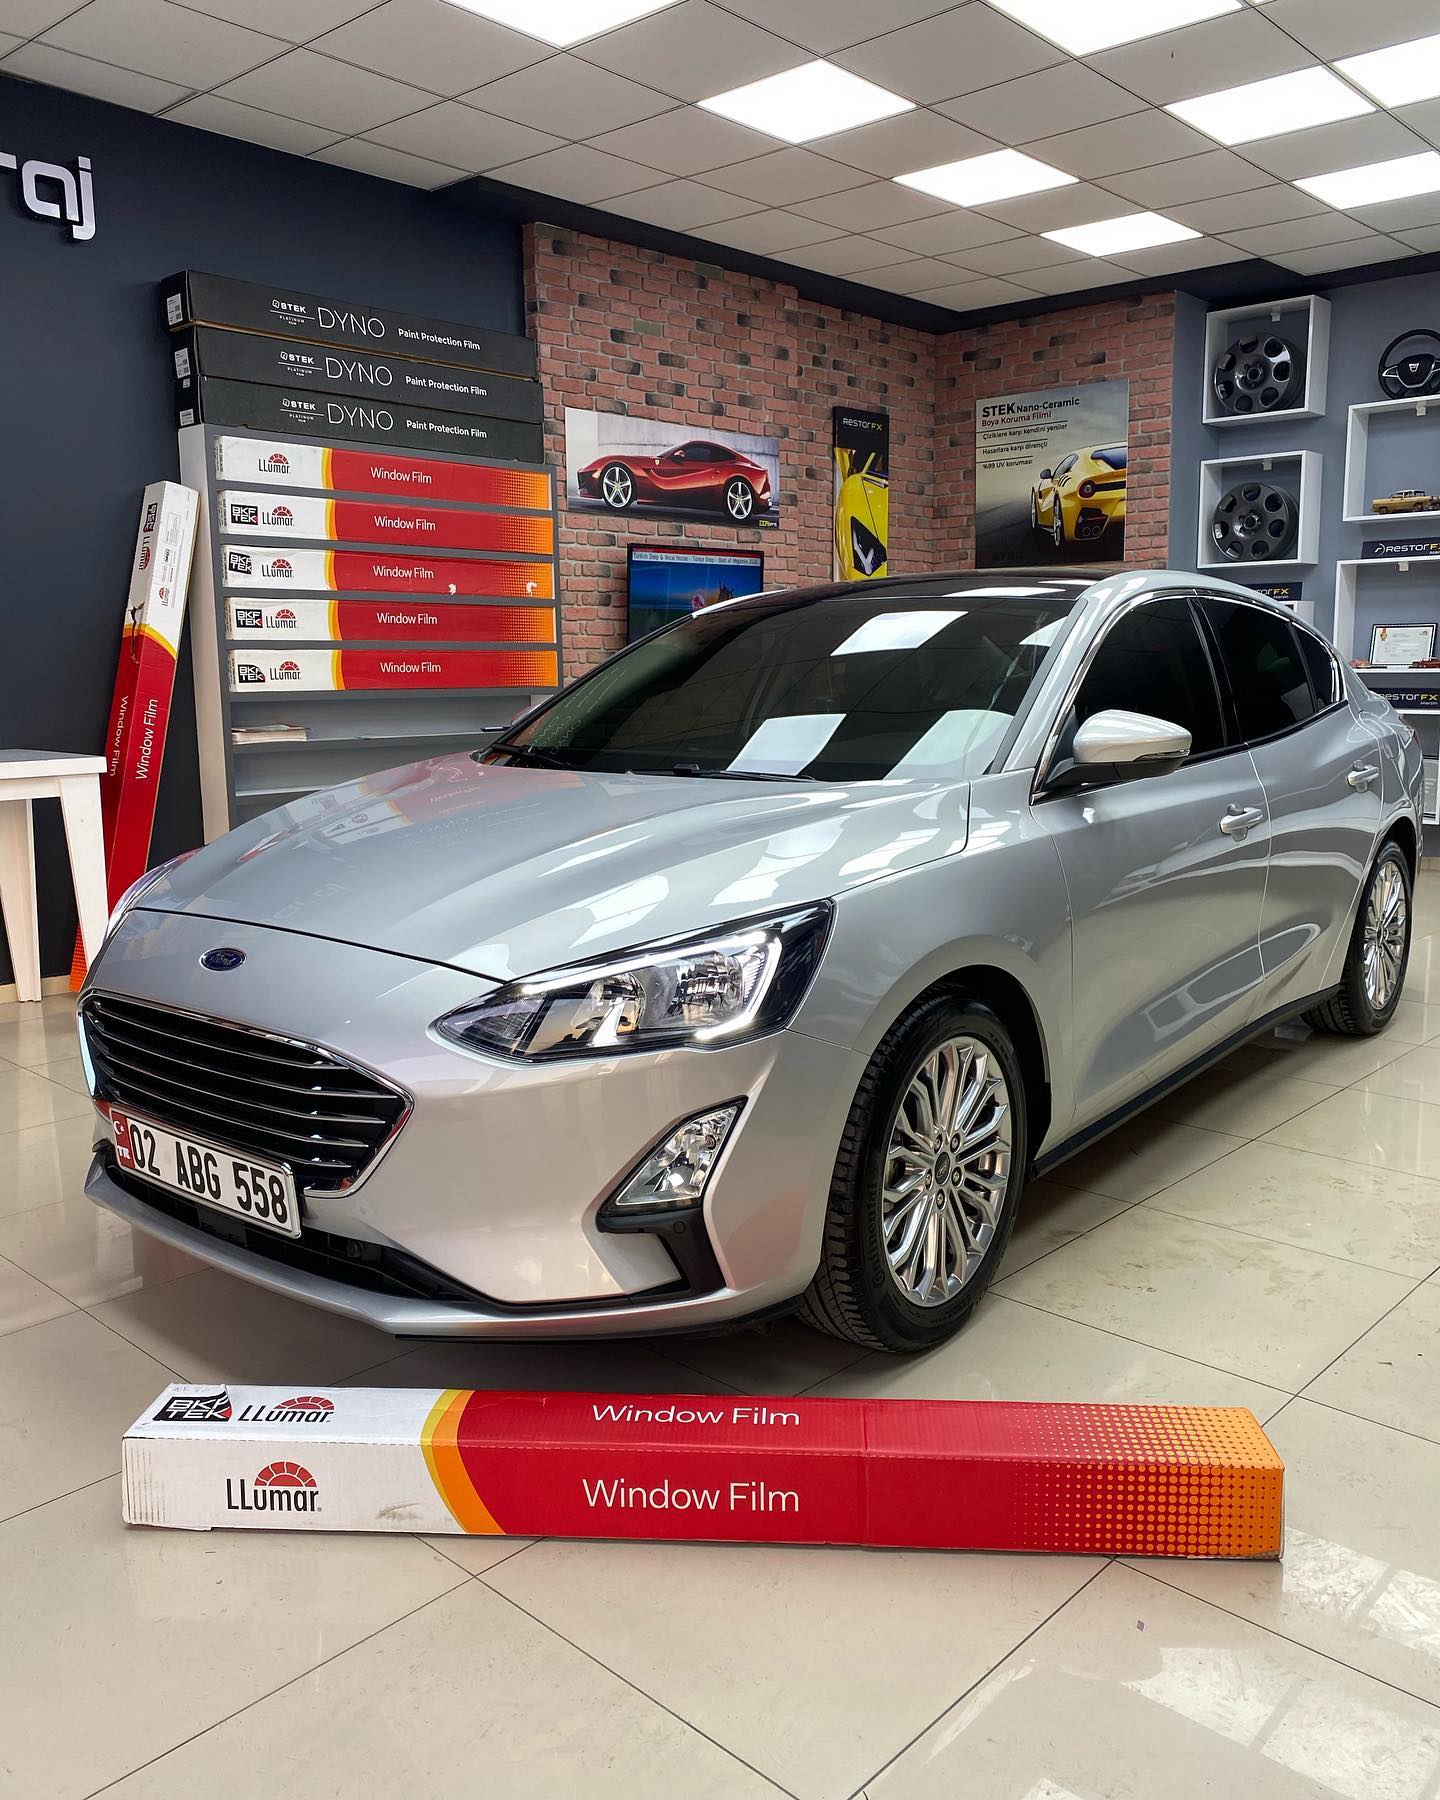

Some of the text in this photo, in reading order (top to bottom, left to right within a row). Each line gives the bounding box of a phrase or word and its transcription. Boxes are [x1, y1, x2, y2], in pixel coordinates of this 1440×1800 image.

[281, 302, 306, 314] STEK
[318, 307, 385, 337] DYNO
[398, 328, 481, 350] Paint Protection Film
[289, 353, 314, 365] STEK
[326, 357, 393, 386] DYNO
[405, 376, 487, 396] Paint Protection Film
[291, 400, 316, 411] STEK
[982, 397, 1080, 418] STEK Nano-Ceramic
[327, 403, 394, 430] DYNO
[981, 410, 1052, 428] Boya Koruma Filmi
[406, 420, 488, 439] Paint Protection Film
[1046, 423, 1068, 433] yeniler
[982, 447, 1010, 455] Hasarlara
[258, 458, 290, 474] LLumar
[1006, 459, 1033, 467] koruması
[370, 466, 432, 484] Window Film
[232, 505, 257, 515] BKF
[231, 514, 257, 524] TEK
[262, 511, 294, 527] LLumar
[374, 515, 436, 531] Window Film
[230, 562, 252, 572] TEK
[262, 564, 293, 578] LLumar
[372, 565, 434, 579] Window Film
[237, 610, 261, 619] BKF
[237, 618, 262, 626] TEK
[265, 615, 297, 629] LLumar
[376, 612, 438, 625] Window Film
[269, 667, 301, 681] LLumar
[380, 661, 442, 673] Window Film
[240, 673, 264, 681] TEK
[110, 695, 129, 777] Window Film
[135, 698, 159, 780] Window Film
[116, 1145, 131, 1160] TR
[129, 1124, 288, 1224] 02 ABG 558
[166, 1407, 231, 1419] TEK
[237, 1404, 334, 1423] LLumar
[591, 1404, 800, 1426] Window Film
[225, 1478, 320, 1513] LLumar
[581, 1477, 800, 1512] Window Film
